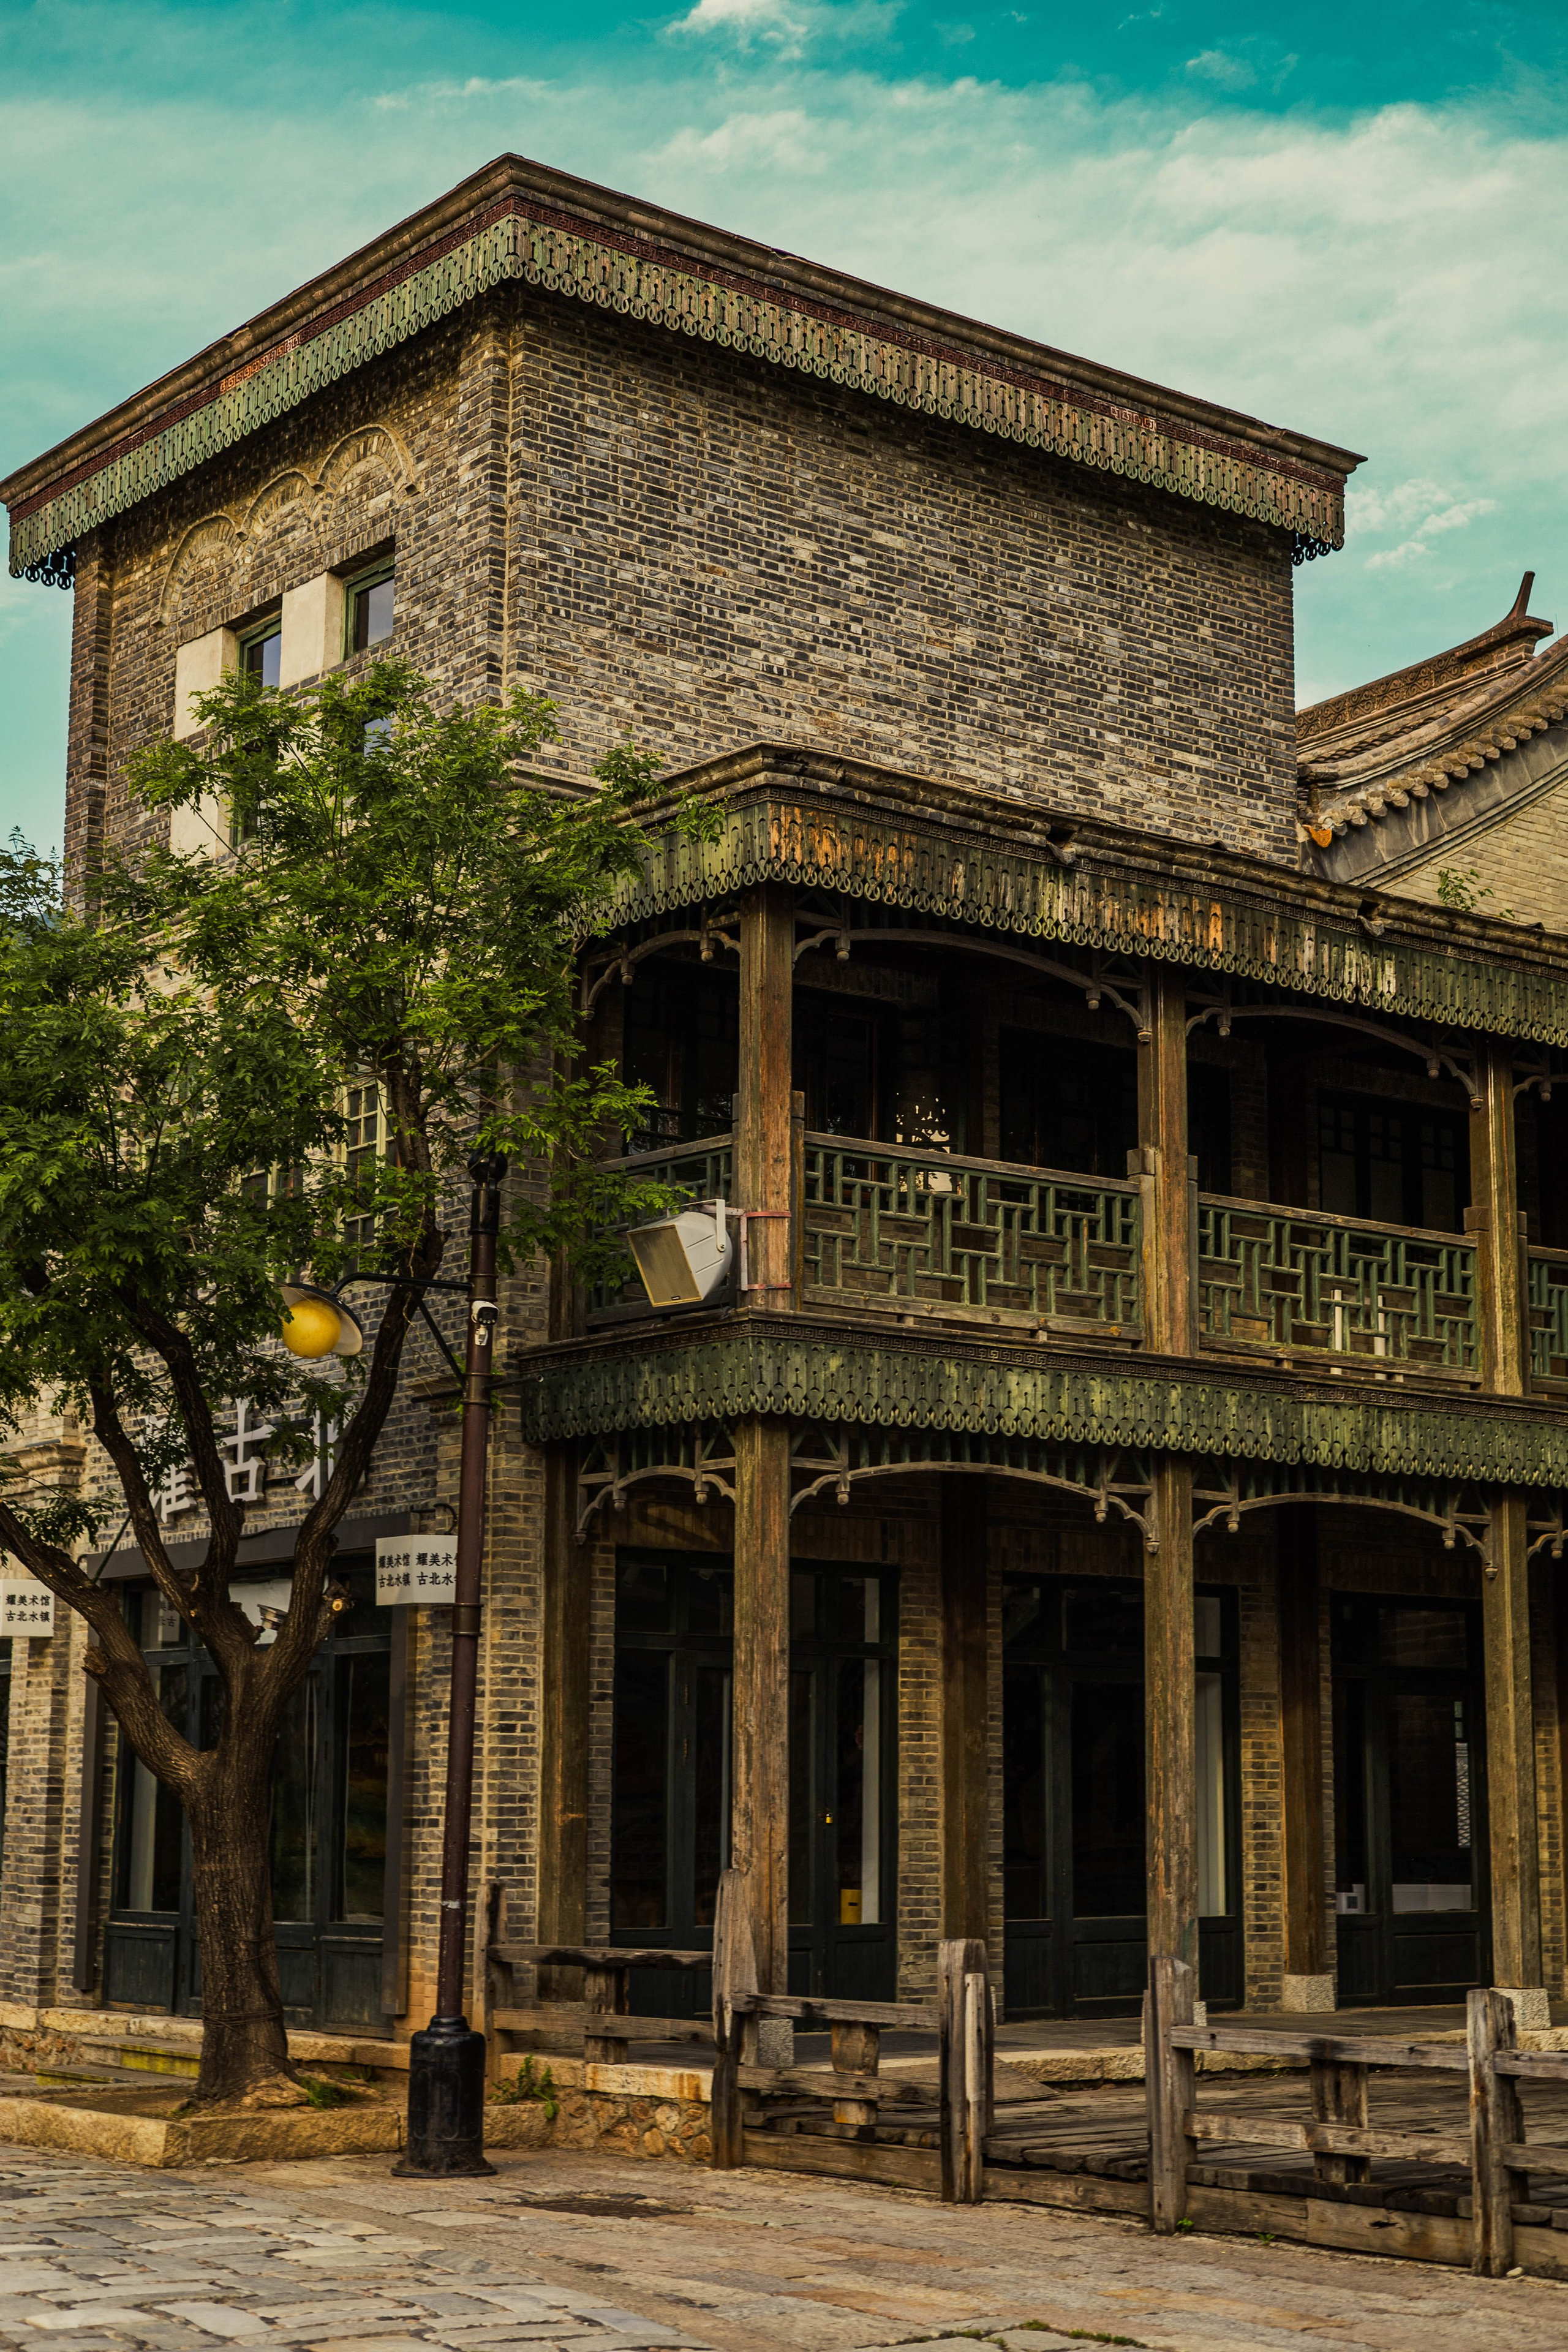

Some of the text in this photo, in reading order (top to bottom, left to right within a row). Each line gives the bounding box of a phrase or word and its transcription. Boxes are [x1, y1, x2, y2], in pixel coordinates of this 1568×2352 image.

[378, 1553, 410, 1569] 耀美术馆
[416, 1553, 458, 1566] 耀美术
[378, 1572, 410, 1588] 古北水镇
[416, 1572, 458, 1586] 古北水
[6, 1594, 50, 1606] 耀美术馆
[6, 1610, 50, 1622] 古北水镇
